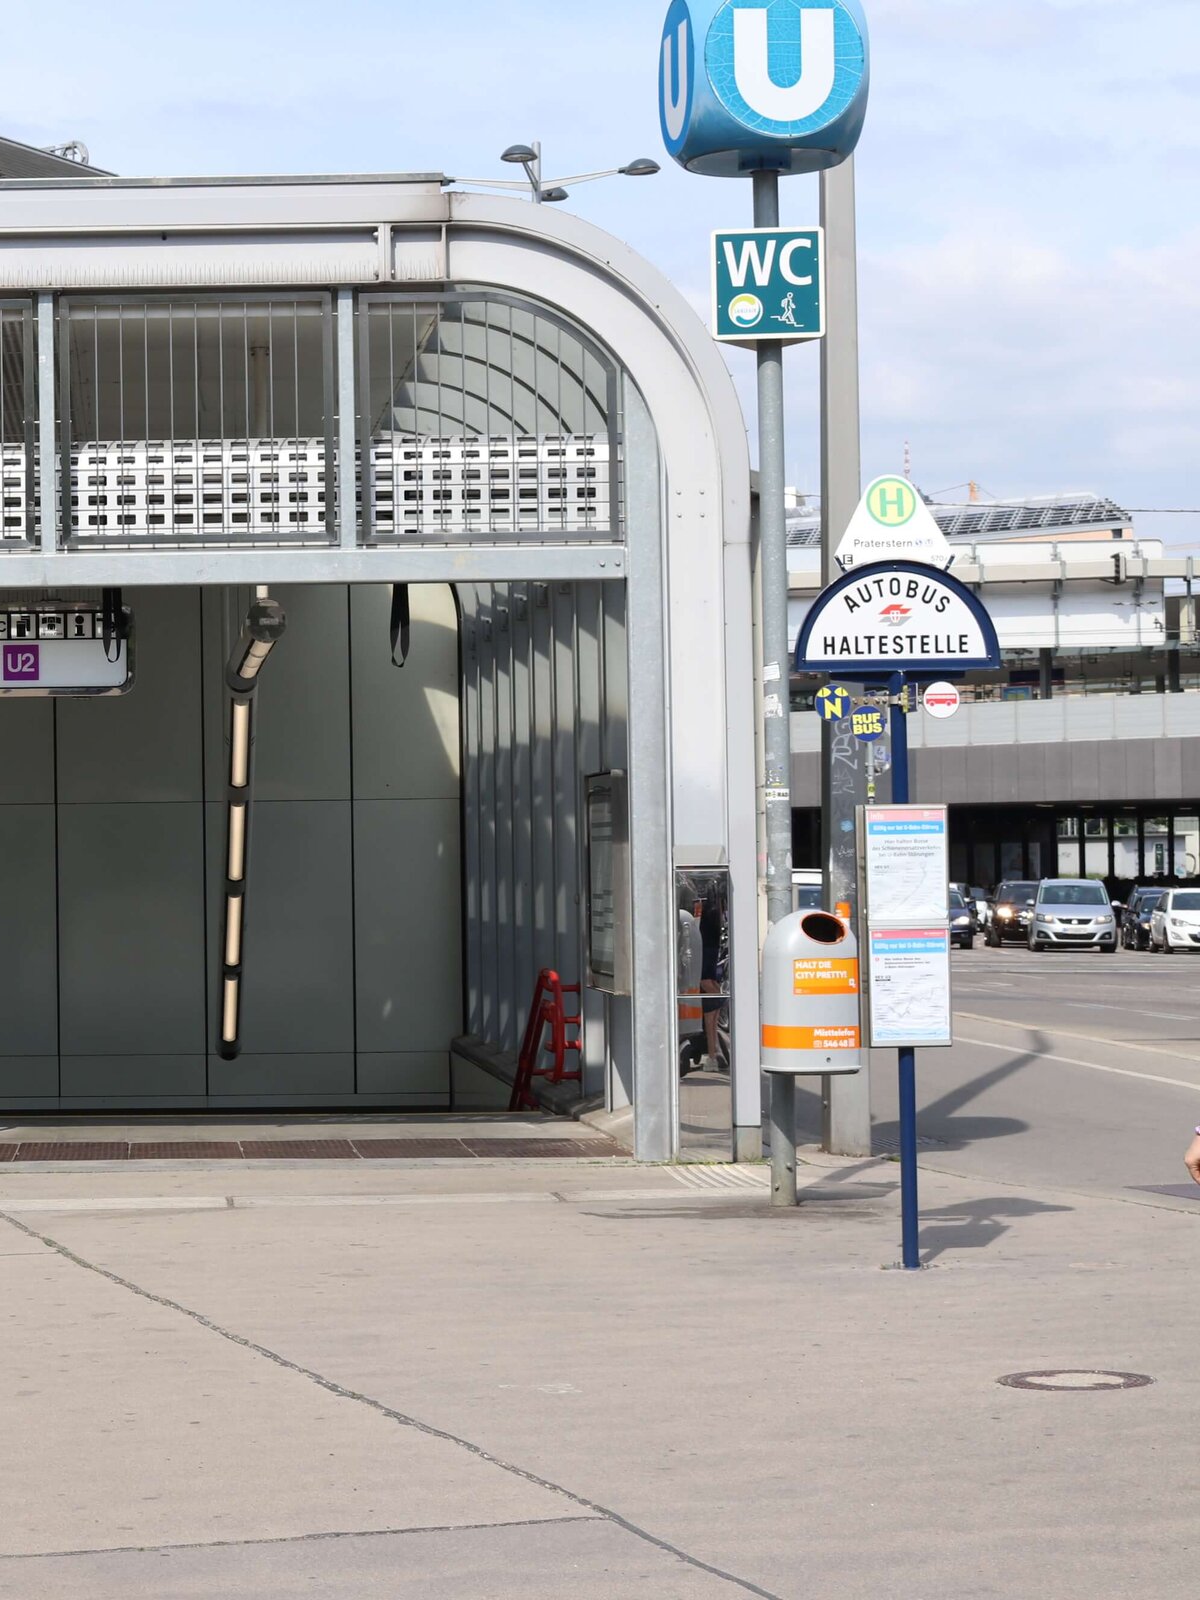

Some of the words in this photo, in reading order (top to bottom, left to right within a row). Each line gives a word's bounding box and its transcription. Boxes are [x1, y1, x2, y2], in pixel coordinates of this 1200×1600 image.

[733, 8, 834, 121] U
[663, 18, 687, 141] U
[722, 238, 812, 287] WC
[879, 488, 904, 517] H
[854, 539, 913, 548] Praterstern
[843, 577, 950, 613] AUTOBUS
[823, 635, 969, 655] HALTESTELLE
[7, 653, 35, 672] U2
[824, 697, 842, 719] N
[852, 712, 881, 724] RUF
[853, 723, 882, 735] BUS
[795, 961, 817, 969] HALT
[795, 971, 816, 979] CITY
[817, 970, 848, 979] PRETTY!
[814, 1028, 855, 1037] Misttelefon
[823, 1039, 838, 1047] 546
